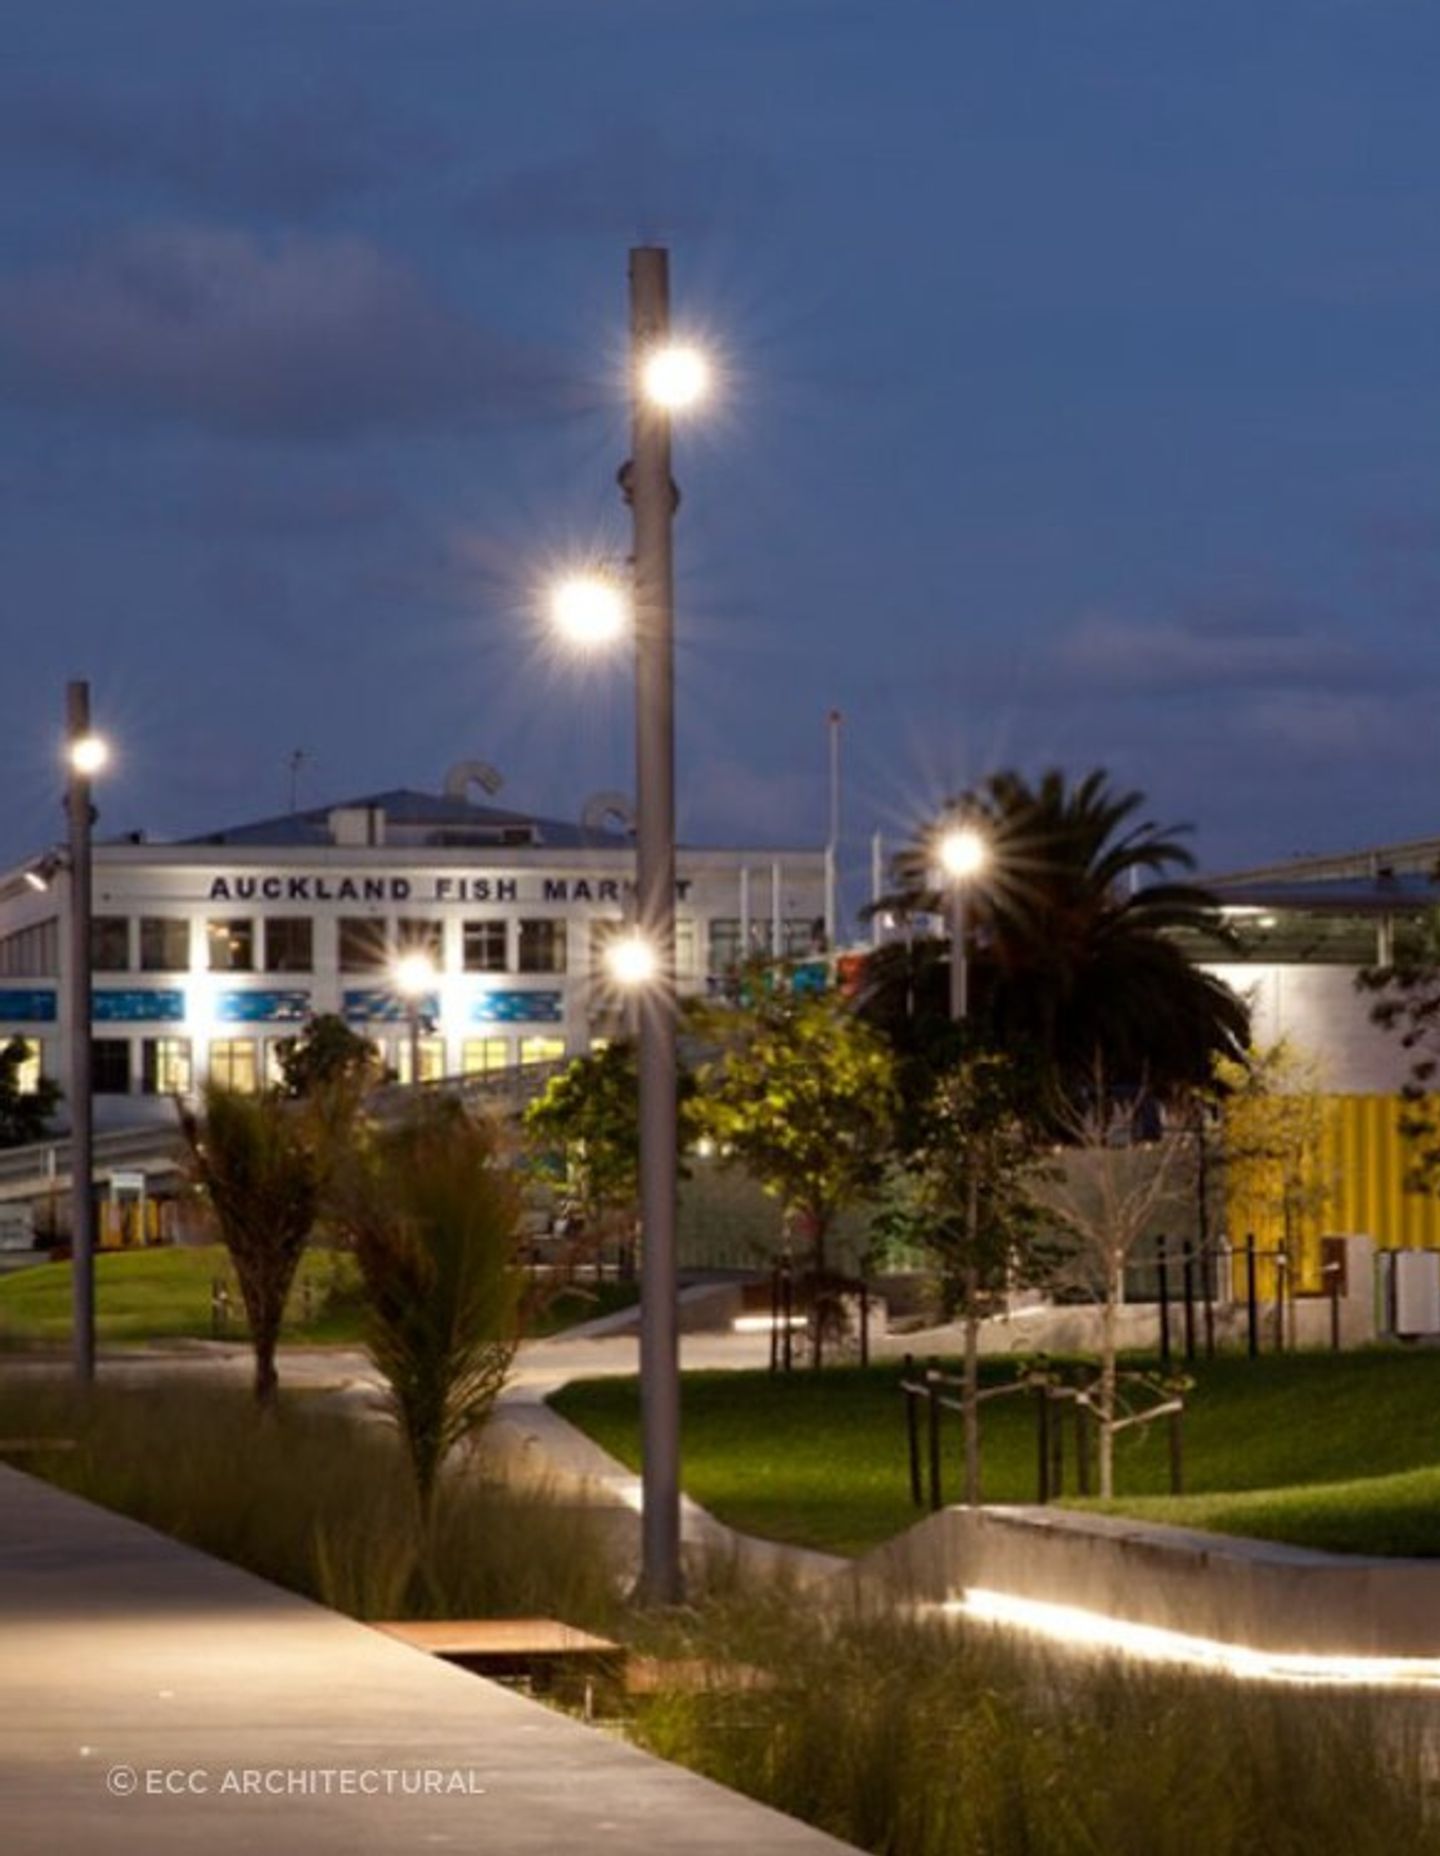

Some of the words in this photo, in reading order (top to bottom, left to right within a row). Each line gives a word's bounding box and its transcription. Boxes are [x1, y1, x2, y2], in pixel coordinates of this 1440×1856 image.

[210, 877, 411, 900] AUCKLAND
[435, 877, 518, 901] FISH
[543, 878, 692, 901] MART
